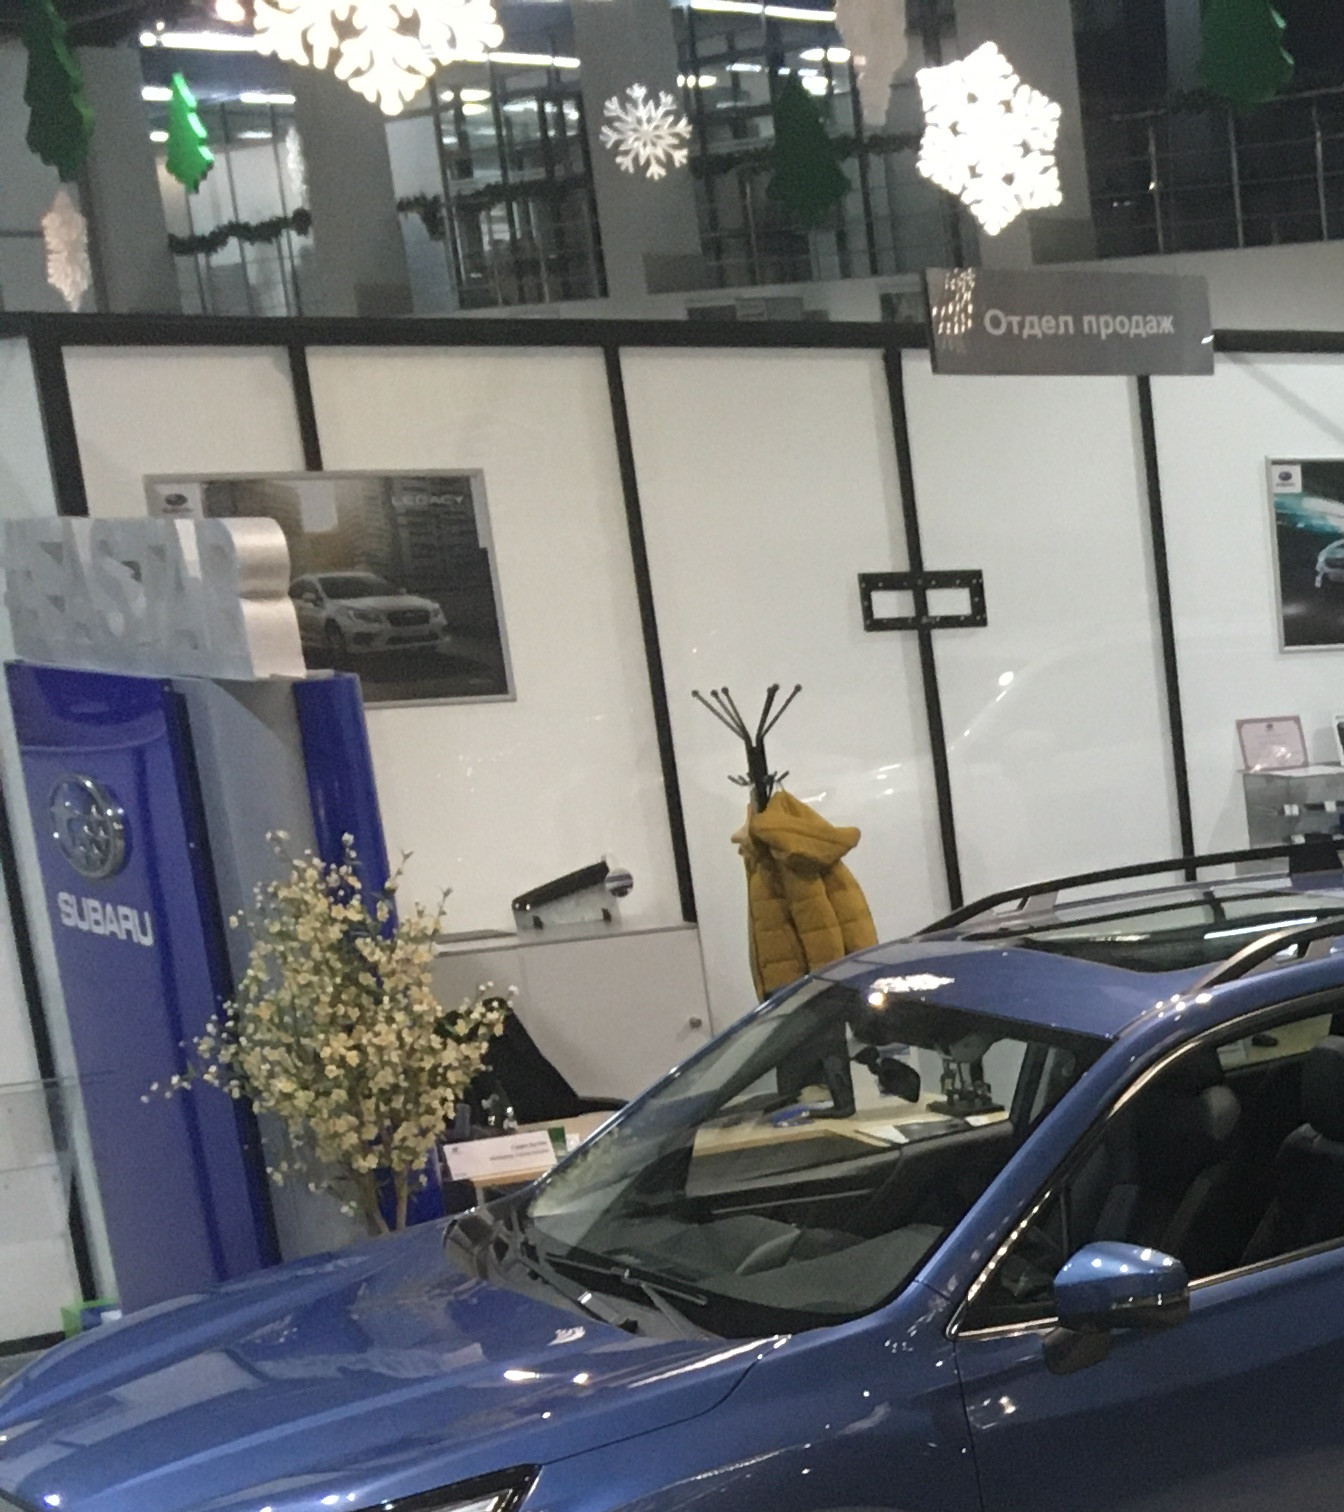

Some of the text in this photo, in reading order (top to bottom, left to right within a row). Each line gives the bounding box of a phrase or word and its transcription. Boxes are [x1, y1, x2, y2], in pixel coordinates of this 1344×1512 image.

[984, 308, 1175, 340] Отдел продаж
[58, 891, 154, 947] SUBARU
